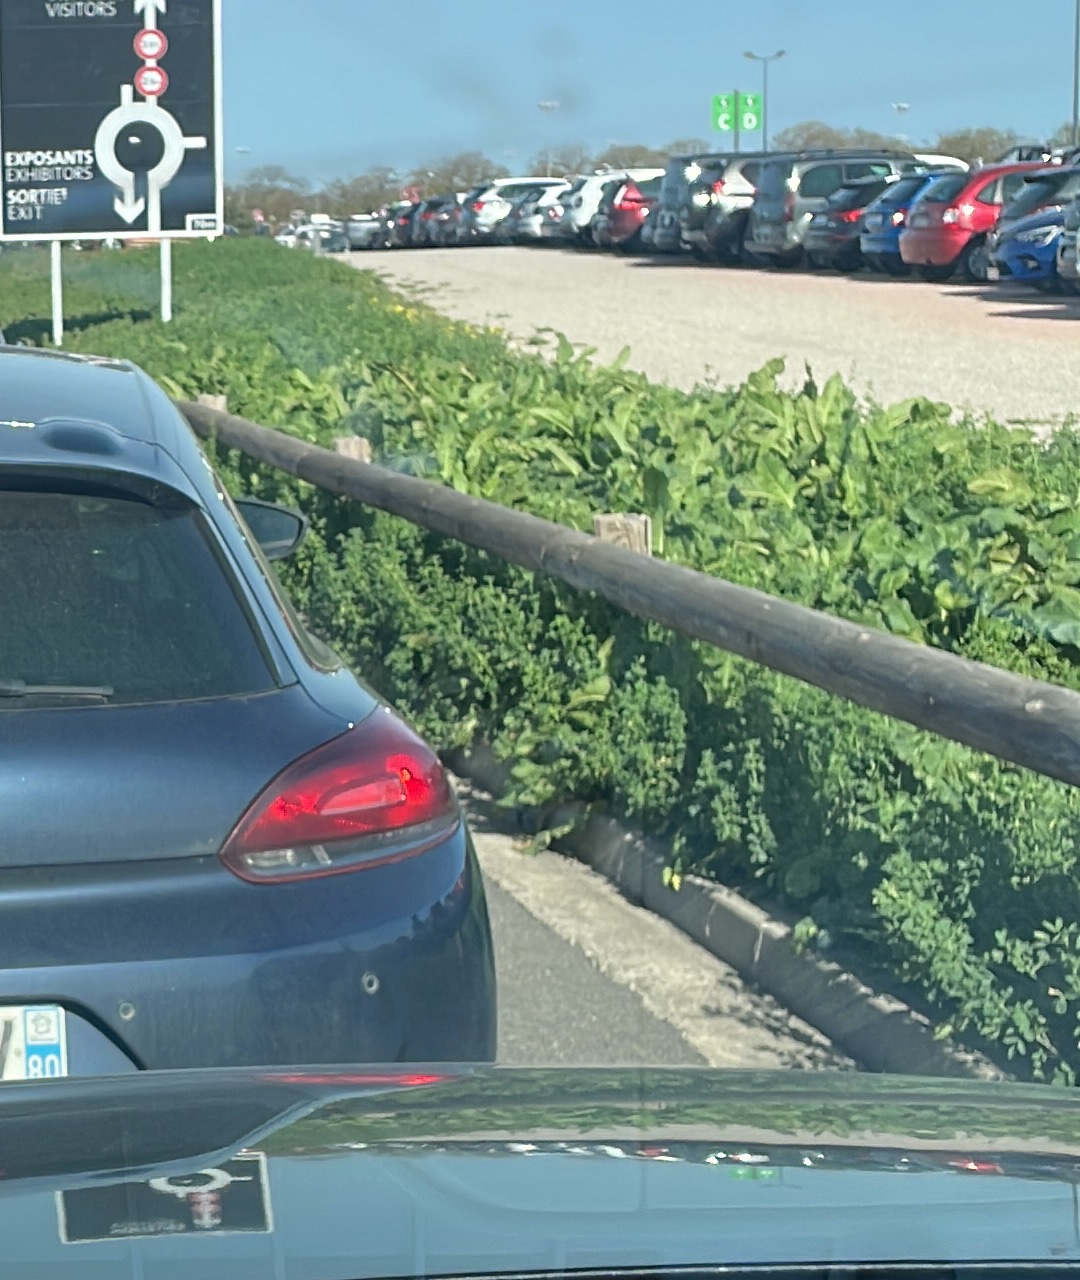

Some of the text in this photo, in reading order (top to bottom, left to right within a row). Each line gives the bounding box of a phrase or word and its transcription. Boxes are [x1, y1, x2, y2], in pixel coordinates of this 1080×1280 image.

[45, 1, 117, 17] VISITORS
[717, 113, 731, 130] C
[743, 112, 757, 130] D
[5, 149, 94, 167] EXPOSANTS
[6, 166, 94, 182] EXHIBITORS
[7, 204, 44, 221] EXIT
[28, 1054, 59, 1078] 80
